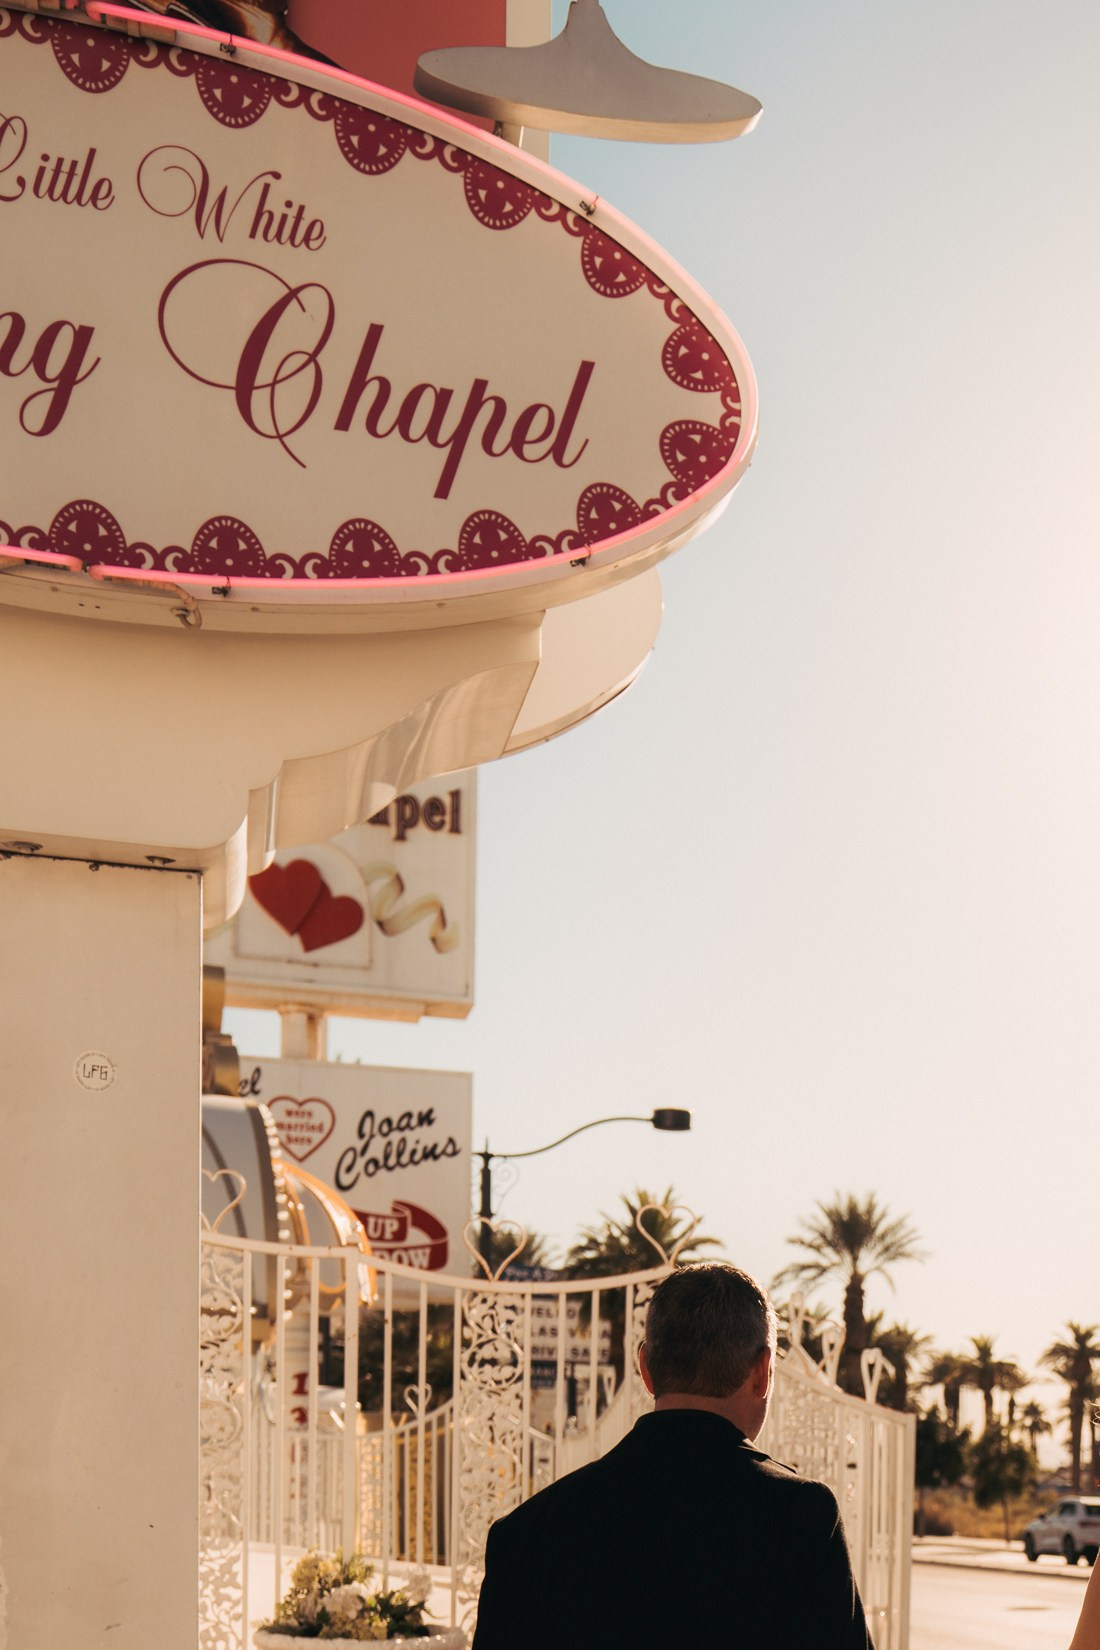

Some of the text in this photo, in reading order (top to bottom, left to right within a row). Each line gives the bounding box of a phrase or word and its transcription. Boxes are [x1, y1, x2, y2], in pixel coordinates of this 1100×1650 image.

[137, 144, 327, 252] White
[157, 257, 596, 500] Chapel
[358, 1106, 437, 1158] Joan
[333, 1137, 462, 1192] Collins
[366, 1216, 400, 1240] UP
